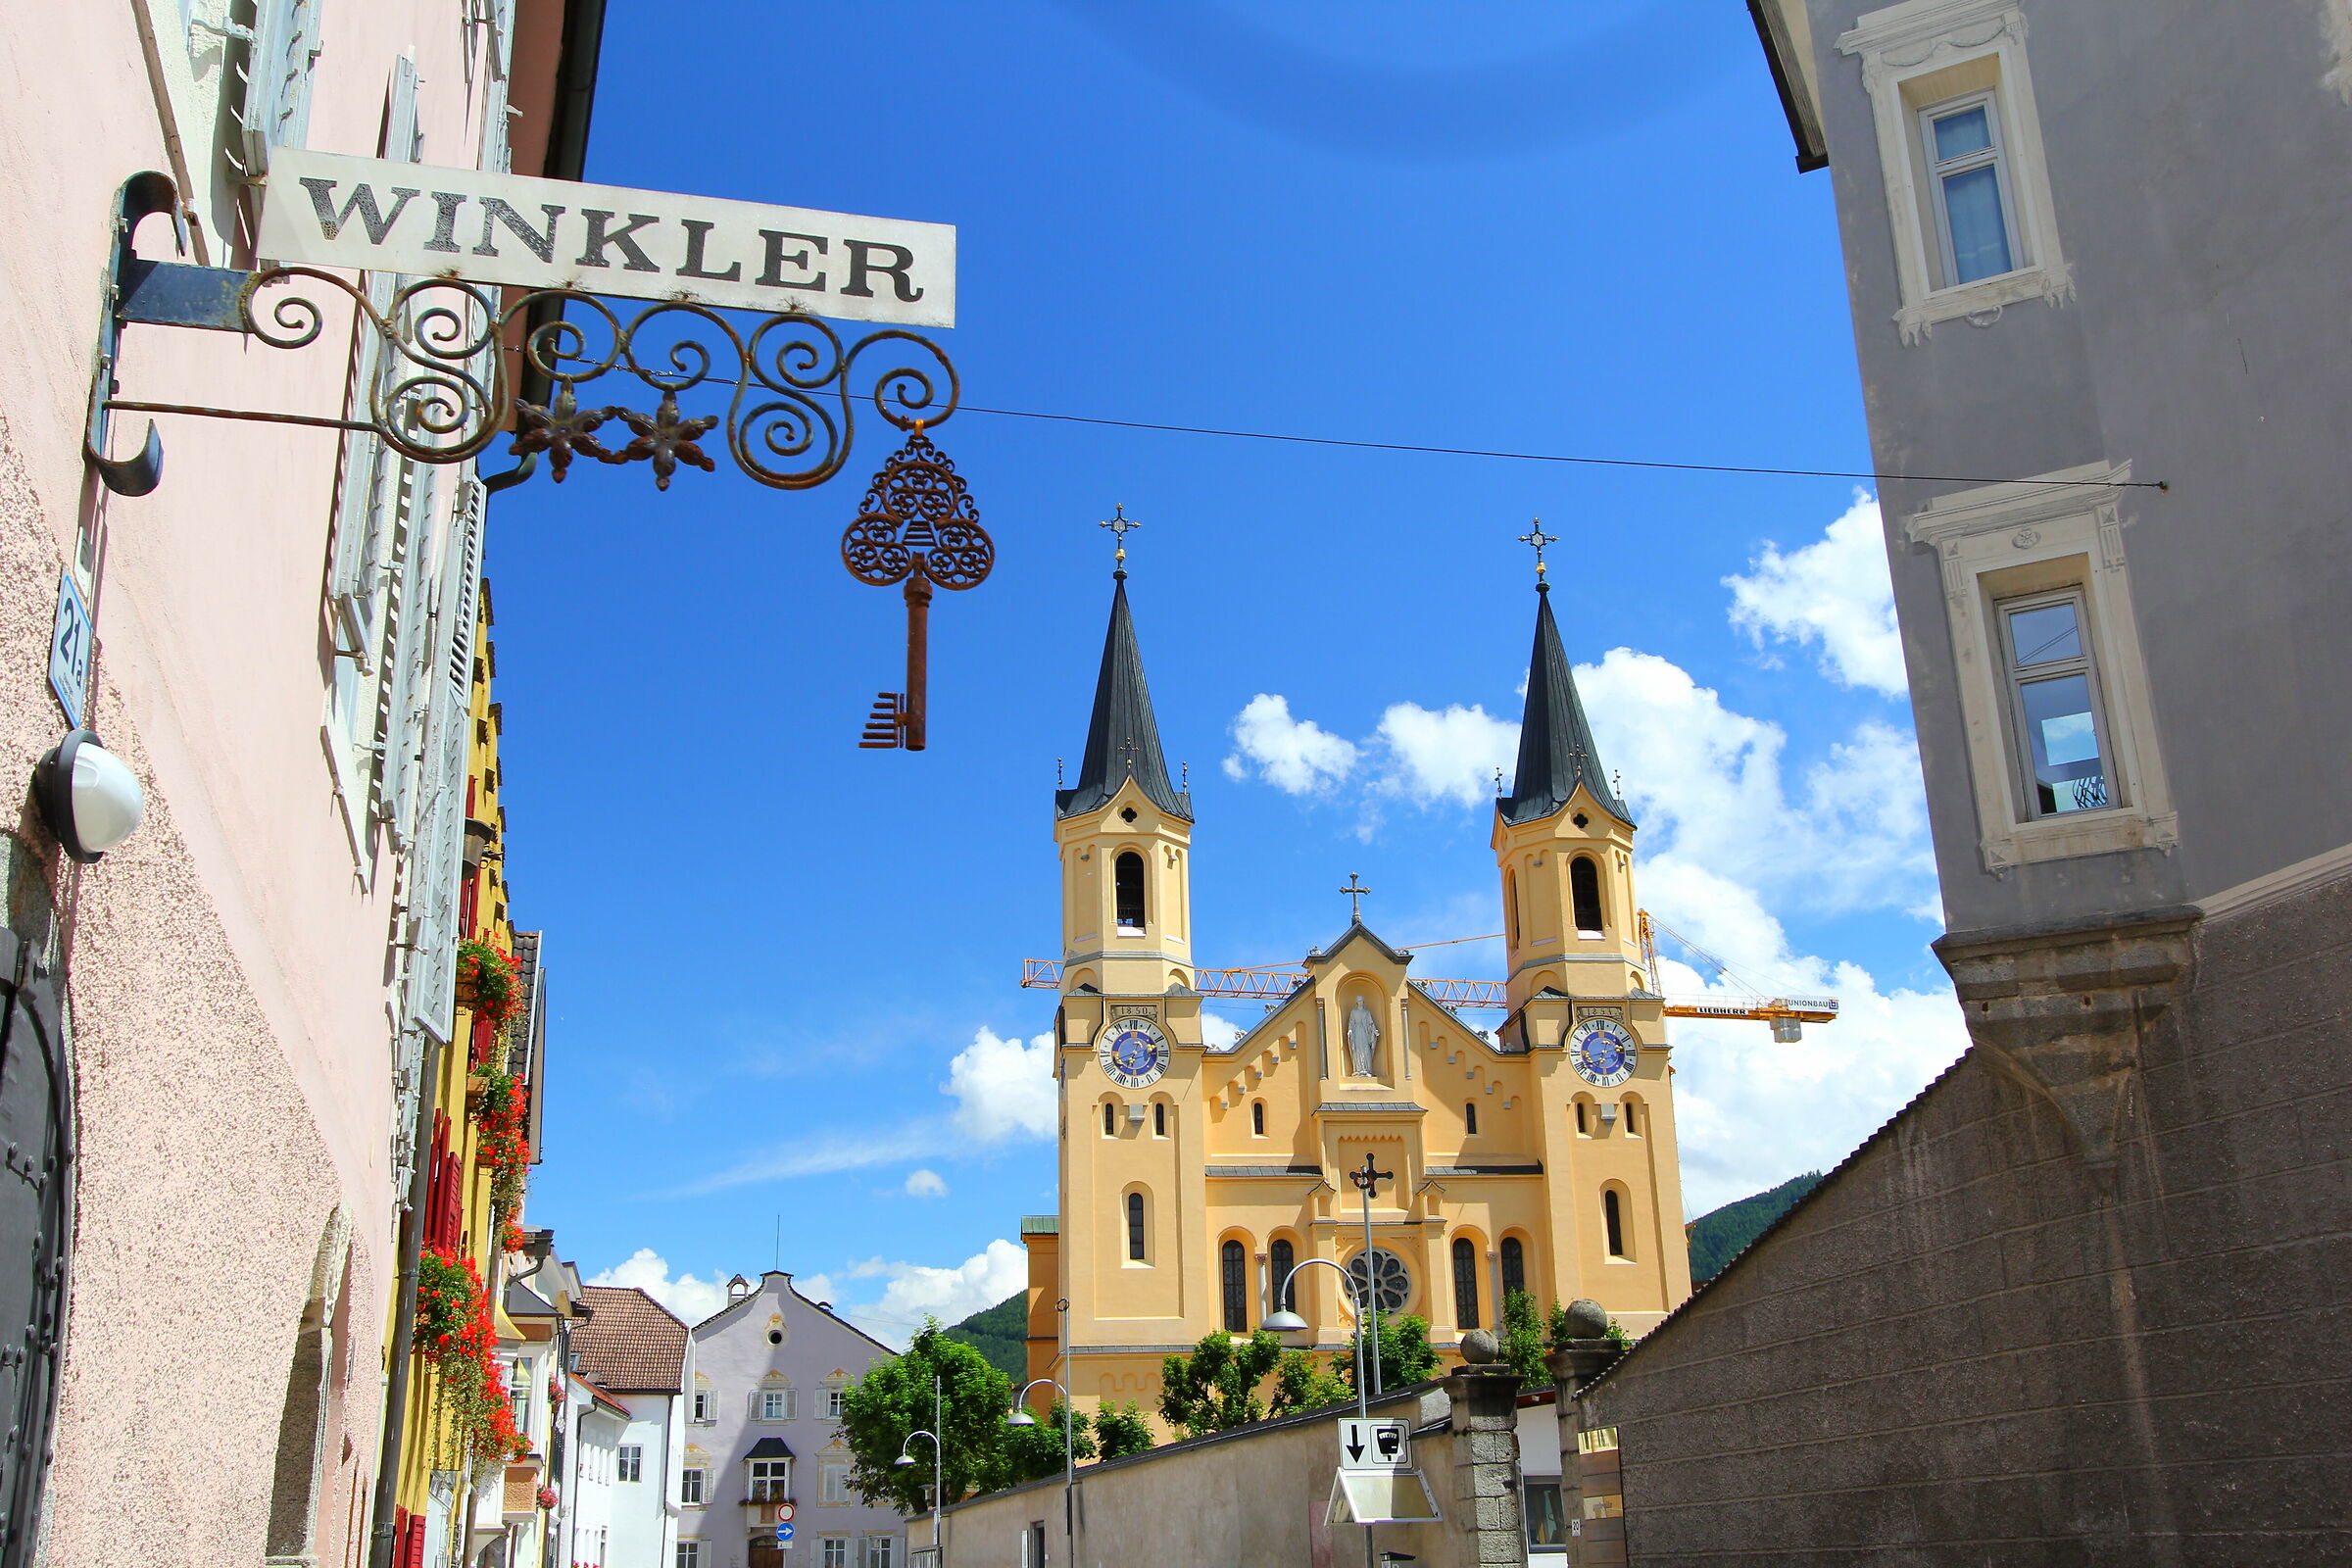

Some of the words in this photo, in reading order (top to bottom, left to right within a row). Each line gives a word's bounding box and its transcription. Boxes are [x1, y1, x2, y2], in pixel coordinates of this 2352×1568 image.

[298, 176, 925, 303] WINKLER
[1788, 999, 1829, 1008] UNIONBAU
[1699, 1006, 1746, 1015] LIEBHERR
